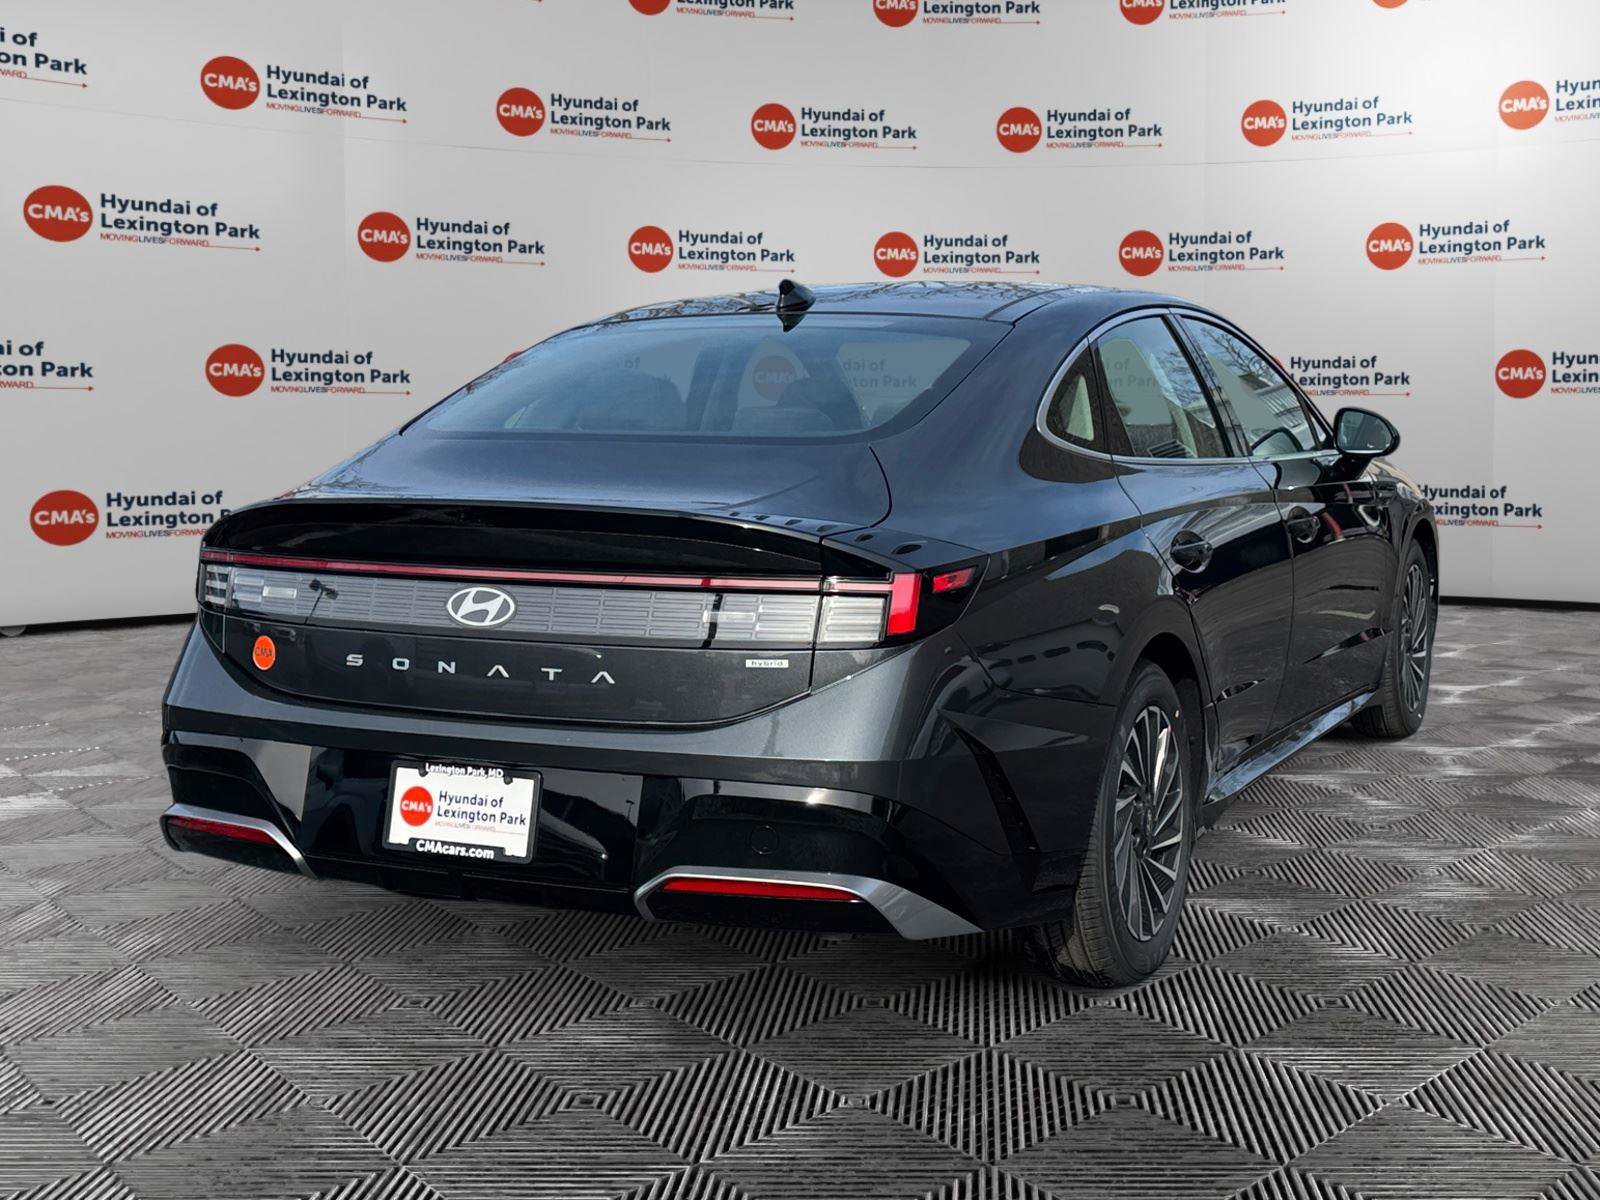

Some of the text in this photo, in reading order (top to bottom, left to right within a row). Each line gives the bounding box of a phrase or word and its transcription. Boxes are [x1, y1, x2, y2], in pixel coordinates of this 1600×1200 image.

[923, 1, 1040, 16] Lexington Park
[11, 32, 38, 47] of
[34, 53, 88, 75] Park
[203, 73, 258, 92] CMA's
[266, 64, 369, 89] Hyundai of
[266, 84, 407, 111] Lexington Park
[551, 93, 639, 112] Hyundai of
[1501, 97, 1547, 113] CMA's
[499, 104, 543, 119] CMA's
[1292, 96, 1379, 116] Hyundai of
[551, 110, 671, 131] Lexington Park
[801, 107, 885, 123] Hyundai of
[1047, 108, 1131, 125] Hyundai of
[1243, 116, 1285, 130] CMA's
[1292, 111, 1412, 132] Lexington Park
[753, 120, 794, 133] CMA's
[801, 124, 917, 140] Lexington Park
[998, 123, 1040, 136] CMA's
[1047, 124, 1162, 140] Lexington Park
[27, 203, 90, 223] CMA's
[100, 193, 218, 217] Hyundai of
[100, 213, 260, 239] Lexington Park
[416, 217, 510, 235] Hyundai of
[1419, 219, 1510, 239] Hyundai of
[361, 229, 409, 245] CMA's
[416, 235, 545, 254] Lexington Park
[679, 230, 763, 246] Hyundai of
[924, 235, 1008, 250] Hyundai of
[1169, 231, 1252, 247] Hyundai of
[1419, 235, 1546, 255] Lexington Park
[630, 242, 671, 256] CMA's
[1121, 247, 1162, 259] CMA's
[1368, 239, 1411, 252] CMA's
[679, 247, 795, 263] Lexington Park
[875, 248, 917, 260] CMA's
[924, 251, 1040, 266] Lexington Park
[1169, 246, 1284, 264] Lexington Park
[19, 341, 44, 356] of
[271, 348, 373, 366] Hyundai of
[1290, 355, 1377, 372] Hyundai of
[41, 361, 93, 378] Park
[209, 362, 262, 377] CMA's
[271, 367, 411, 385] Lexington Park
[1498, 366, 1544, 380] CMA's
[1374, 372, 1410, 385] Park
[106, 490, 223, 510] Hyundai of
[1490, 485, 1507, 499] of
[33, 509, 96, 525] CMA's
[1434, 502, 1542, 519] xington Park
[107, 511, 214, 528] Lexington
[346, 654, 616, 684] SONATA
[425, 762, 465, 776] Lexington
[401, 800, 432, 813] CMA's
[439, 790, 504, 808] Hyundai of
[437, 805, 496, 823] Lexington
[499, 812, 527, 826] Park
[415, 839, 495, 859] CMAcars.com
